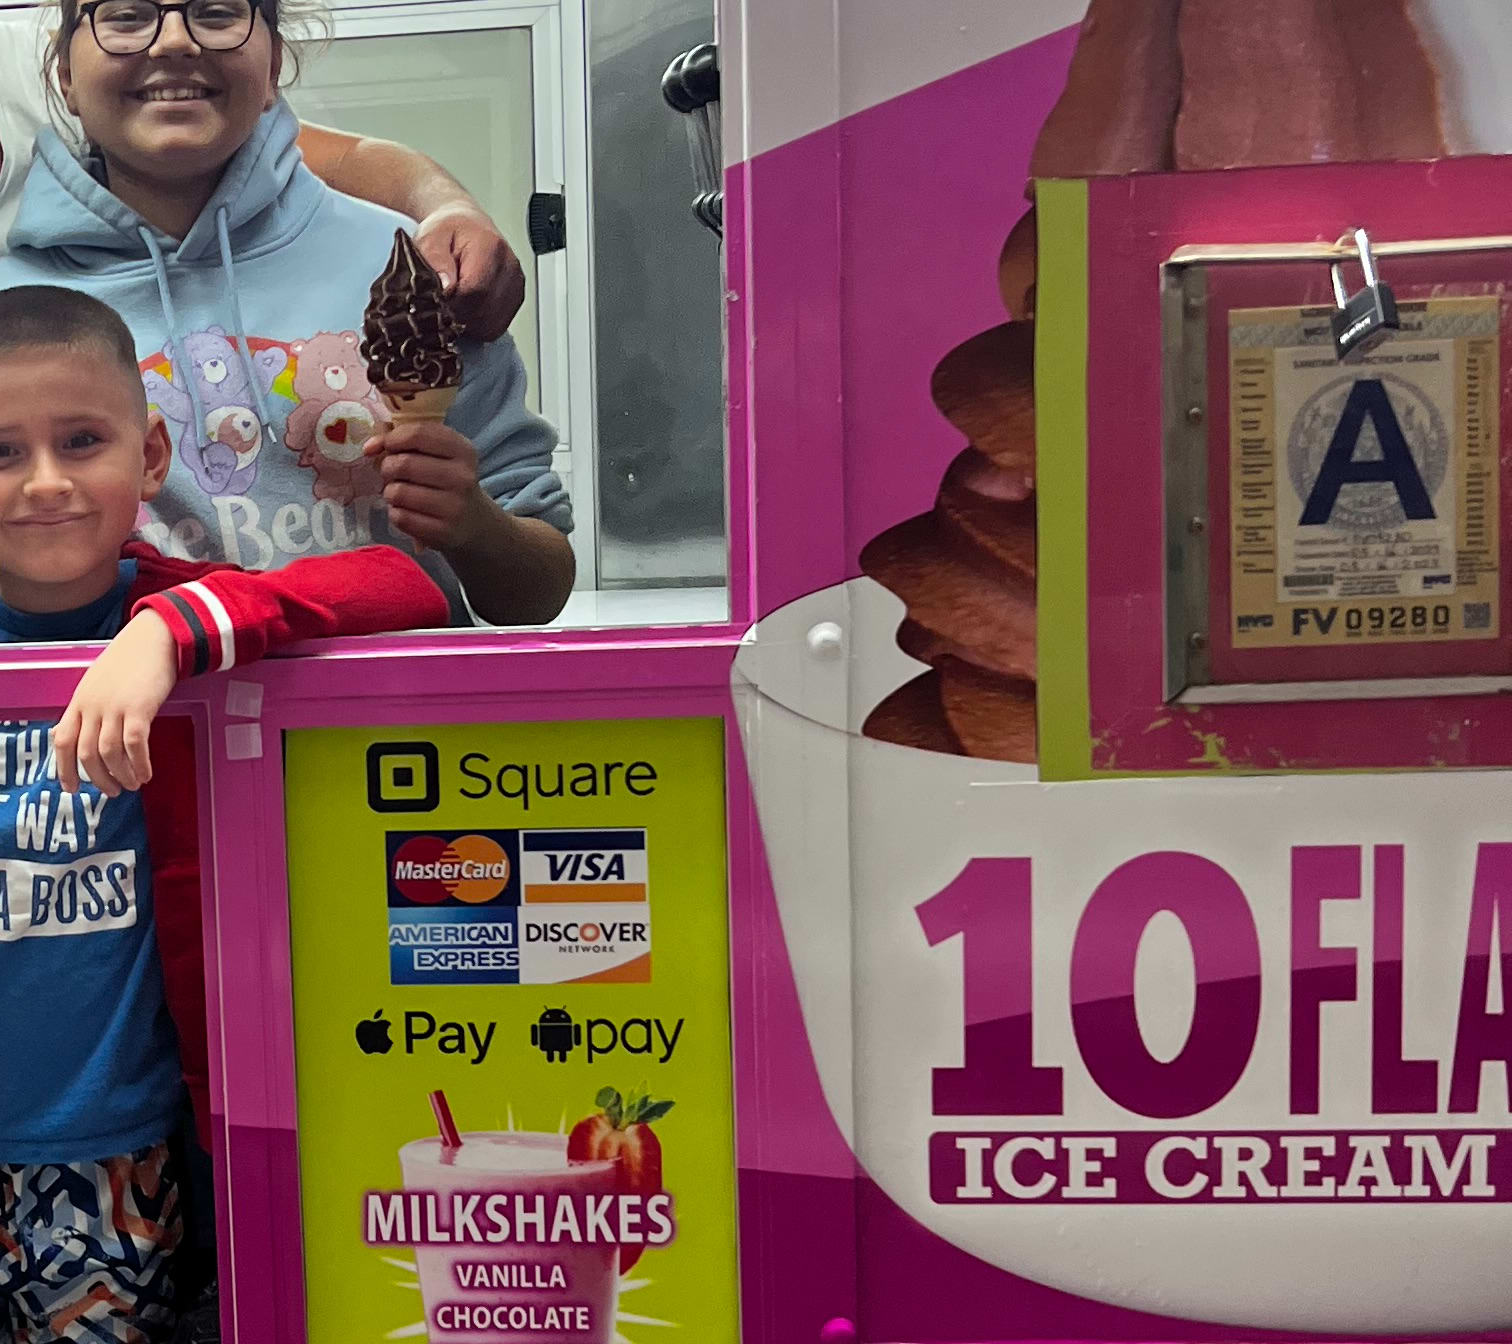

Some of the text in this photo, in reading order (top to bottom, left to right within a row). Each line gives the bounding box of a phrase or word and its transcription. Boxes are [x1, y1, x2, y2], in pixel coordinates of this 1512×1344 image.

[1298, 379, 1436, 526] A
[458, 752, 657, 811] Square
[16, 790, 109, 853] WAY
[395, 857, 507, 881] MasterCard
[544, 853, 625, 882] VISA
[29, 863, 129, 927] BOSS
[389, 923, 512, 944] AMERICAN
[525, 922, 647, 943] DISCOVER
[558, 945, 615, 954] NETWORK
[415, 948, 519, 970] EXPRESS
[404, 1011, 497, 1065] Pay
[587, 1017, 684, 1064] pay
[955, 1134, 1496, 1199] ICE CREAM
[367, 1194, 672, 1244] MILKSHAKES
[456, 1264, 566, 1288] VANILLA
[436, 1306, 589, 1330] CHOCOLATE
